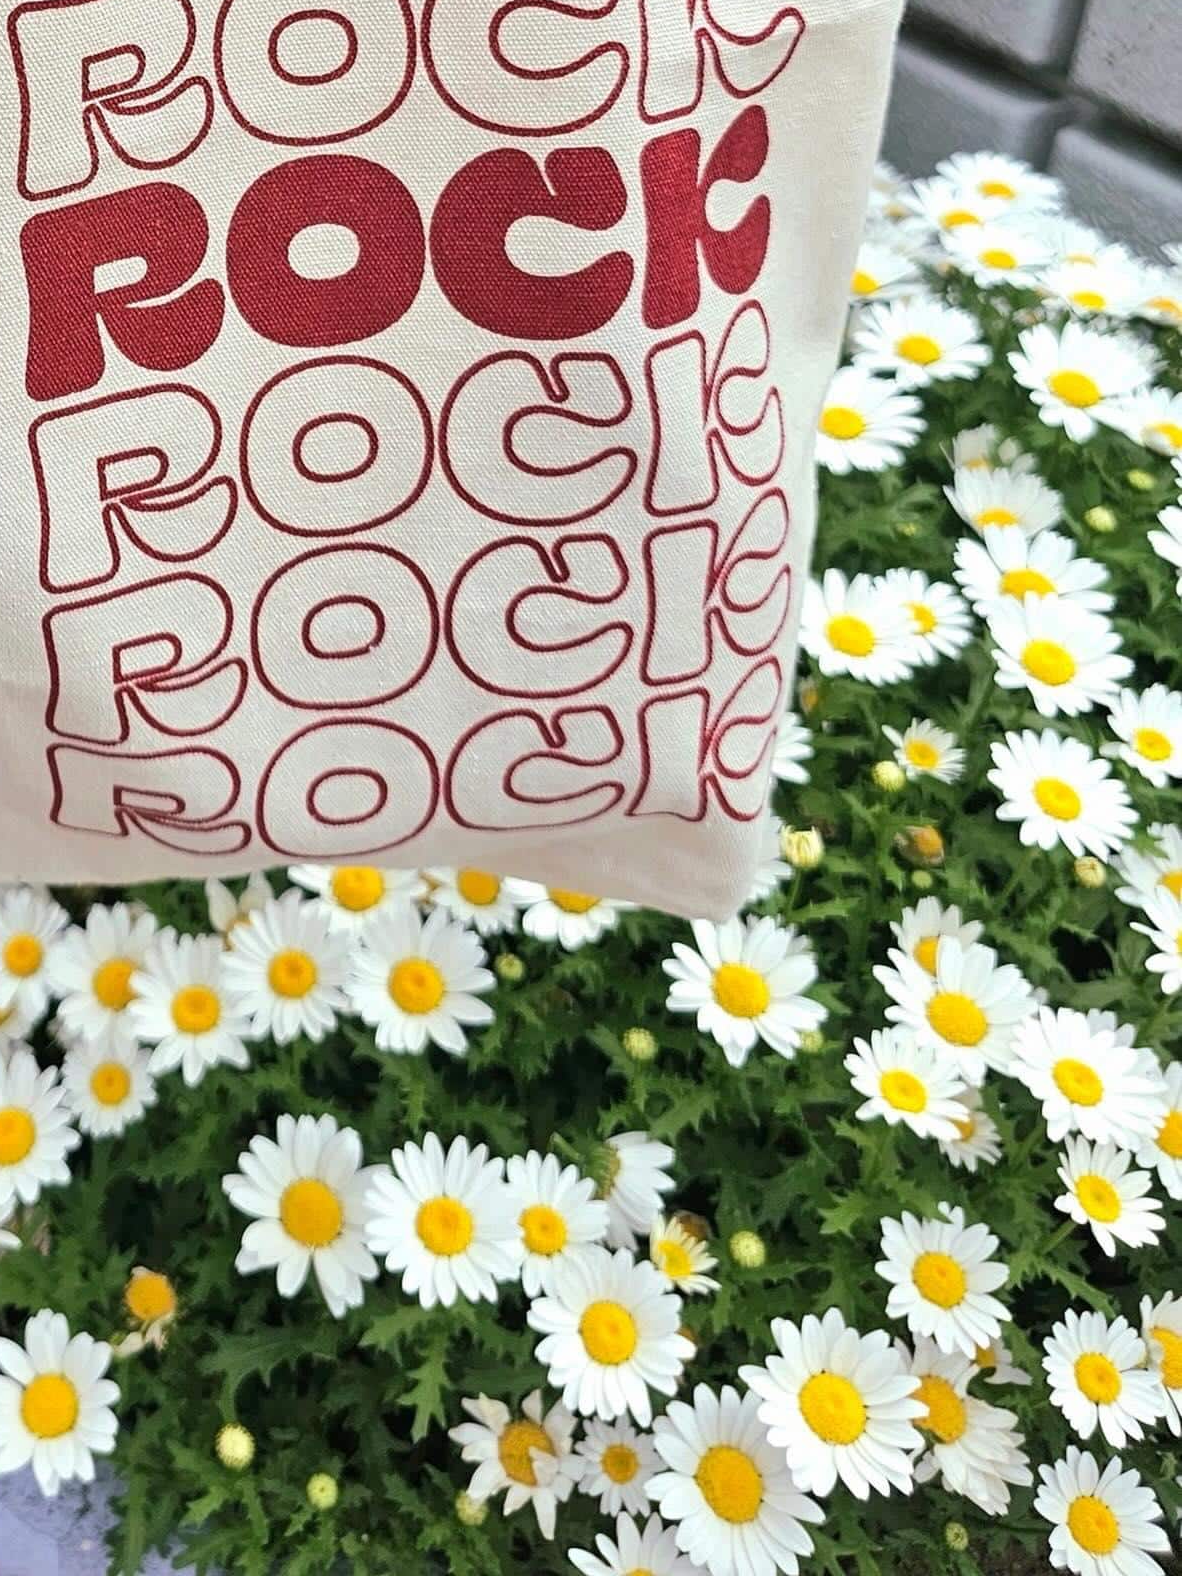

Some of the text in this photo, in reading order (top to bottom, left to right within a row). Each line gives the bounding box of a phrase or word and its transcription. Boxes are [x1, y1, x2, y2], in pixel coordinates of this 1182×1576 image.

[19, 104, 771, 401] ROCK
[28, 300, 784, 594] ROCK
[42, 488, 791, 744] ROCK
[46, 656, 782, 858] ROCK
